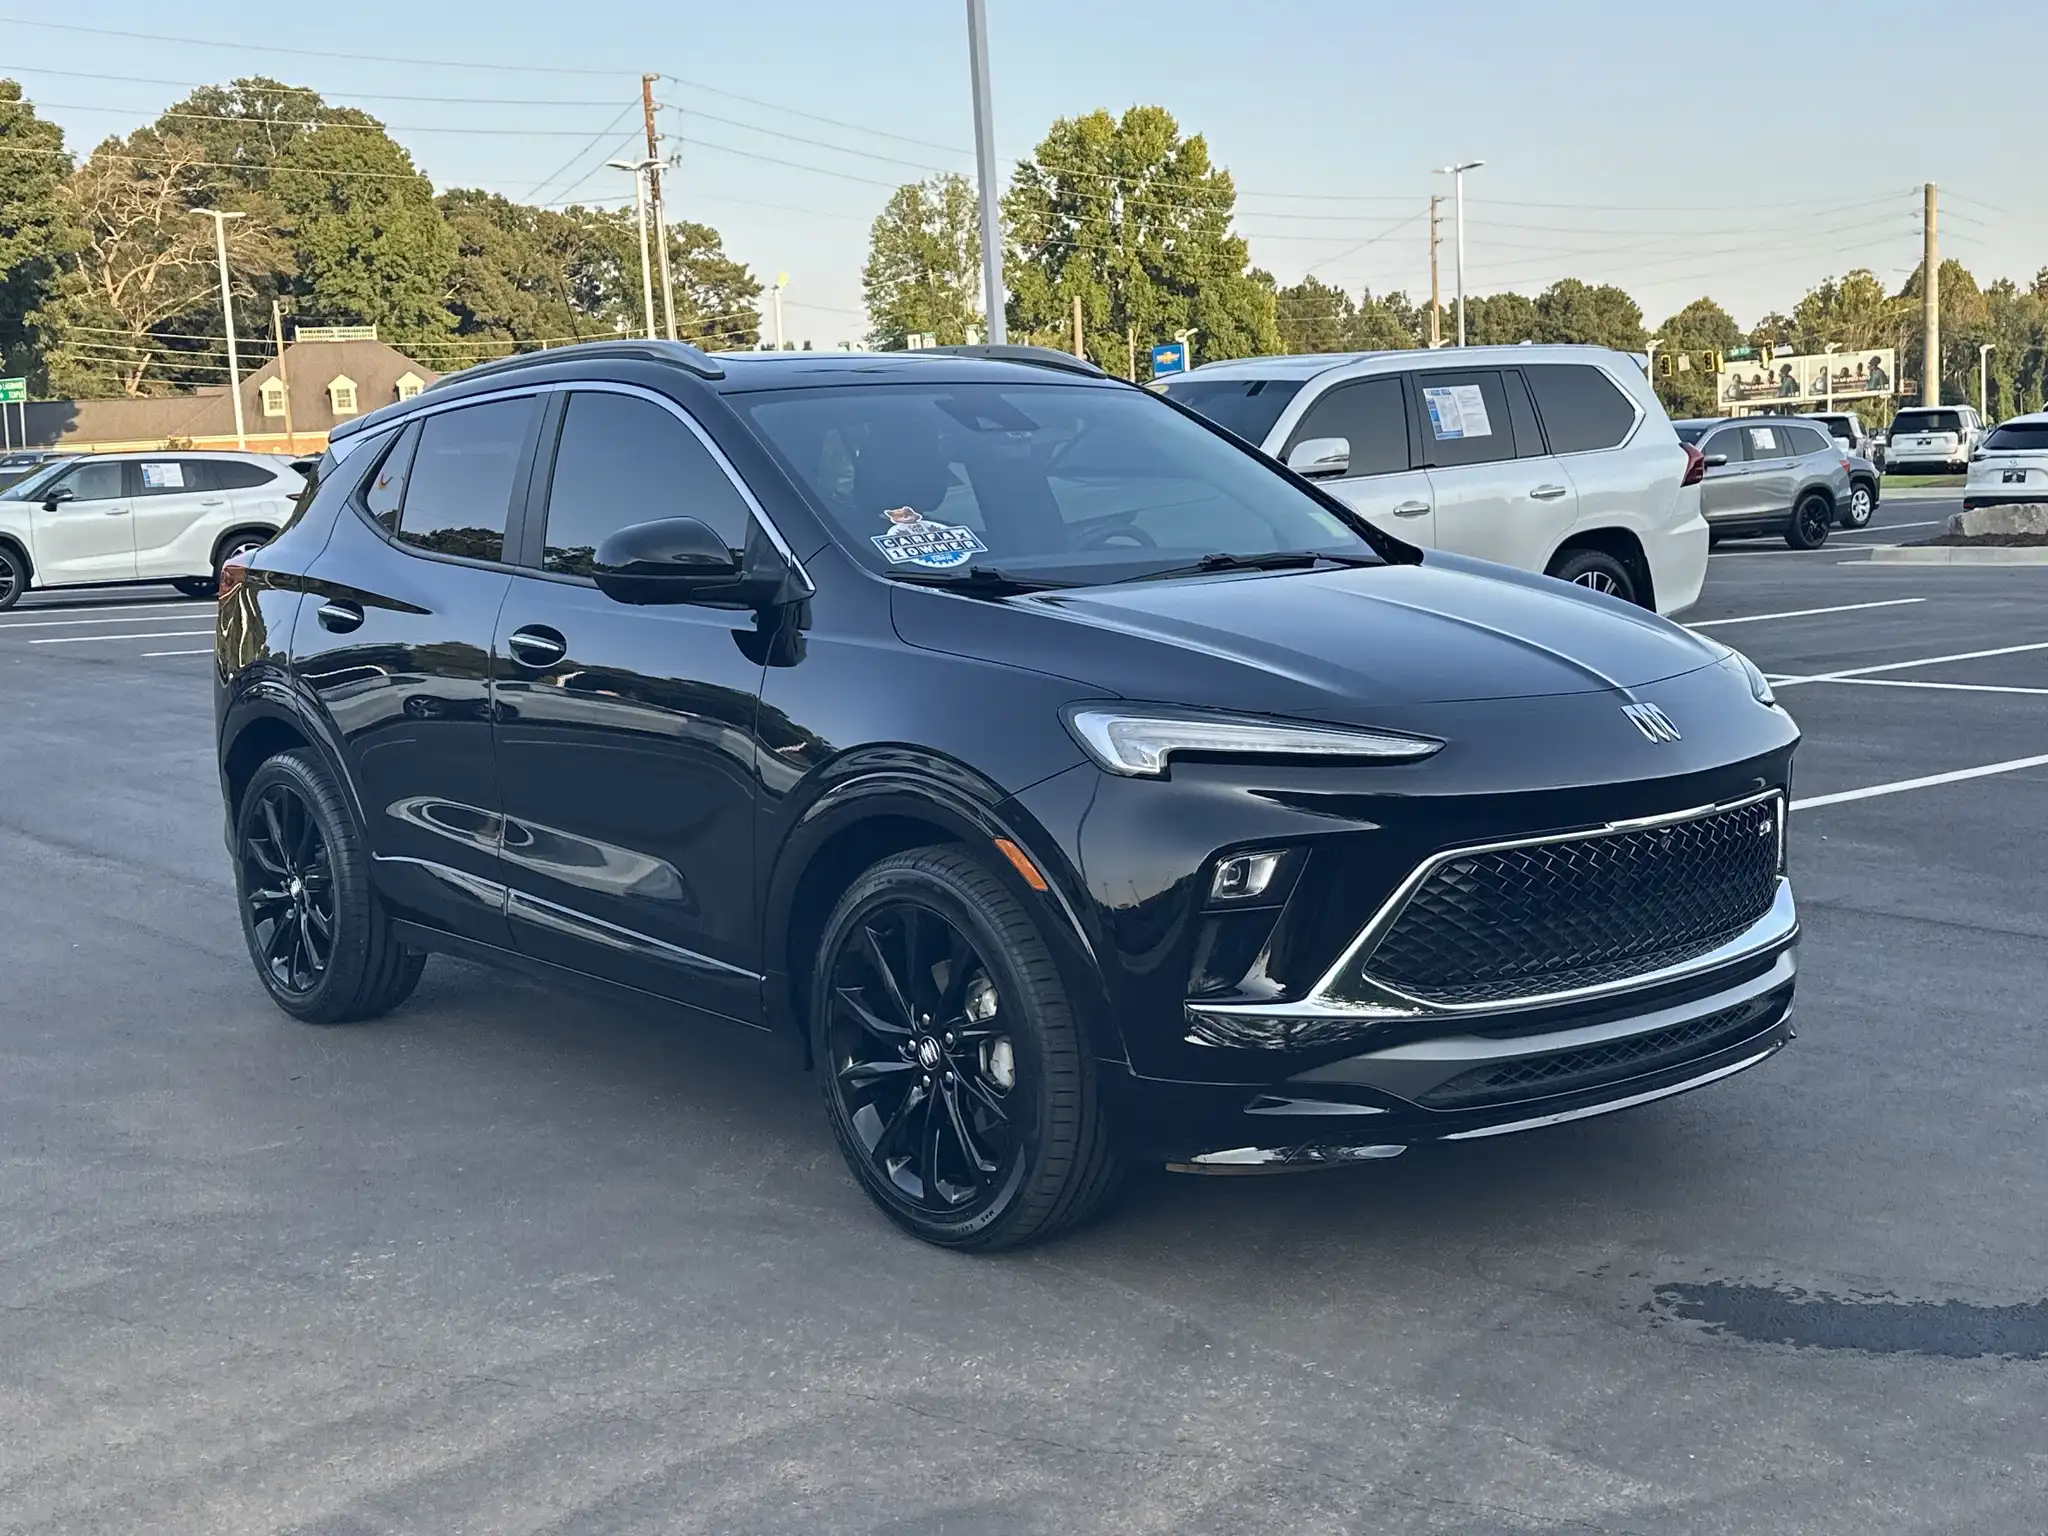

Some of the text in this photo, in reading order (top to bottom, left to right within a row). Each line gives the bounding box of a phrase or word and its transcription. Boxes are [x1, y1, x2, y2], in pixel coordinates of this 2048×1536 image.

[883, 532, 969, 548] CARFAX
[892, 549, 904, 558] 1
[906, 540, 976, 556] OWNER
